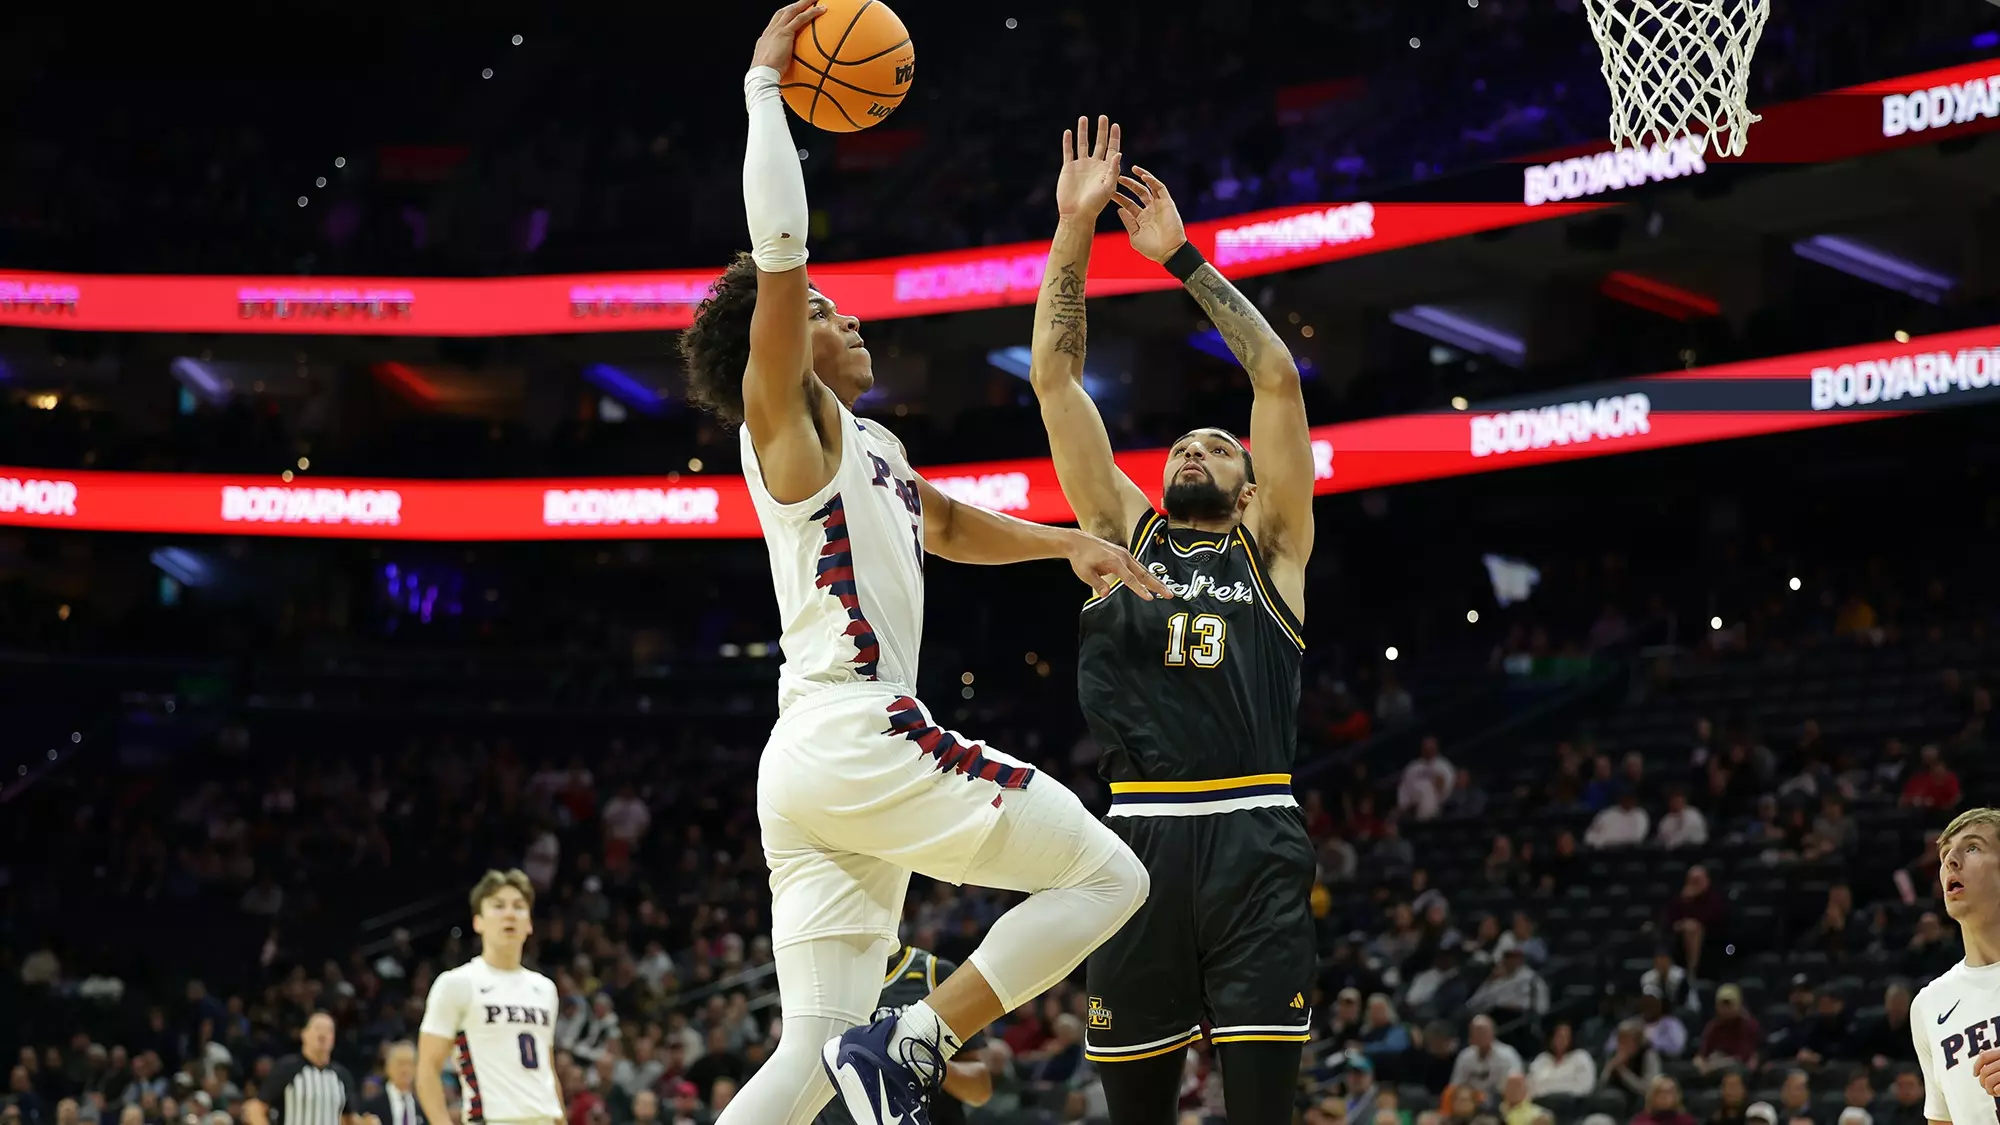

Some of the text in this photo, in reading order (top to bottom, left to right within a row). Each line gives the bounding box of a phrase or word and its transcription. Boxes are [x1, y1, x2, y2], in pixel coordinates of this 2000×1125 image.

[1524, 134, 1706, 206] BODYARMOR
[895, 255, 1047, 301] BODYARMO
[1470, 393, 1650, 457] BODYARMOR
[221, 486, 401, 525] BODYARMOR
[543, 488, 719, 526] BODYARMOR
[1165, 613, 1227, 668] 13
[485, 1005, 549, 1027] PENN
[518, 1033, 538, 1069] 0
